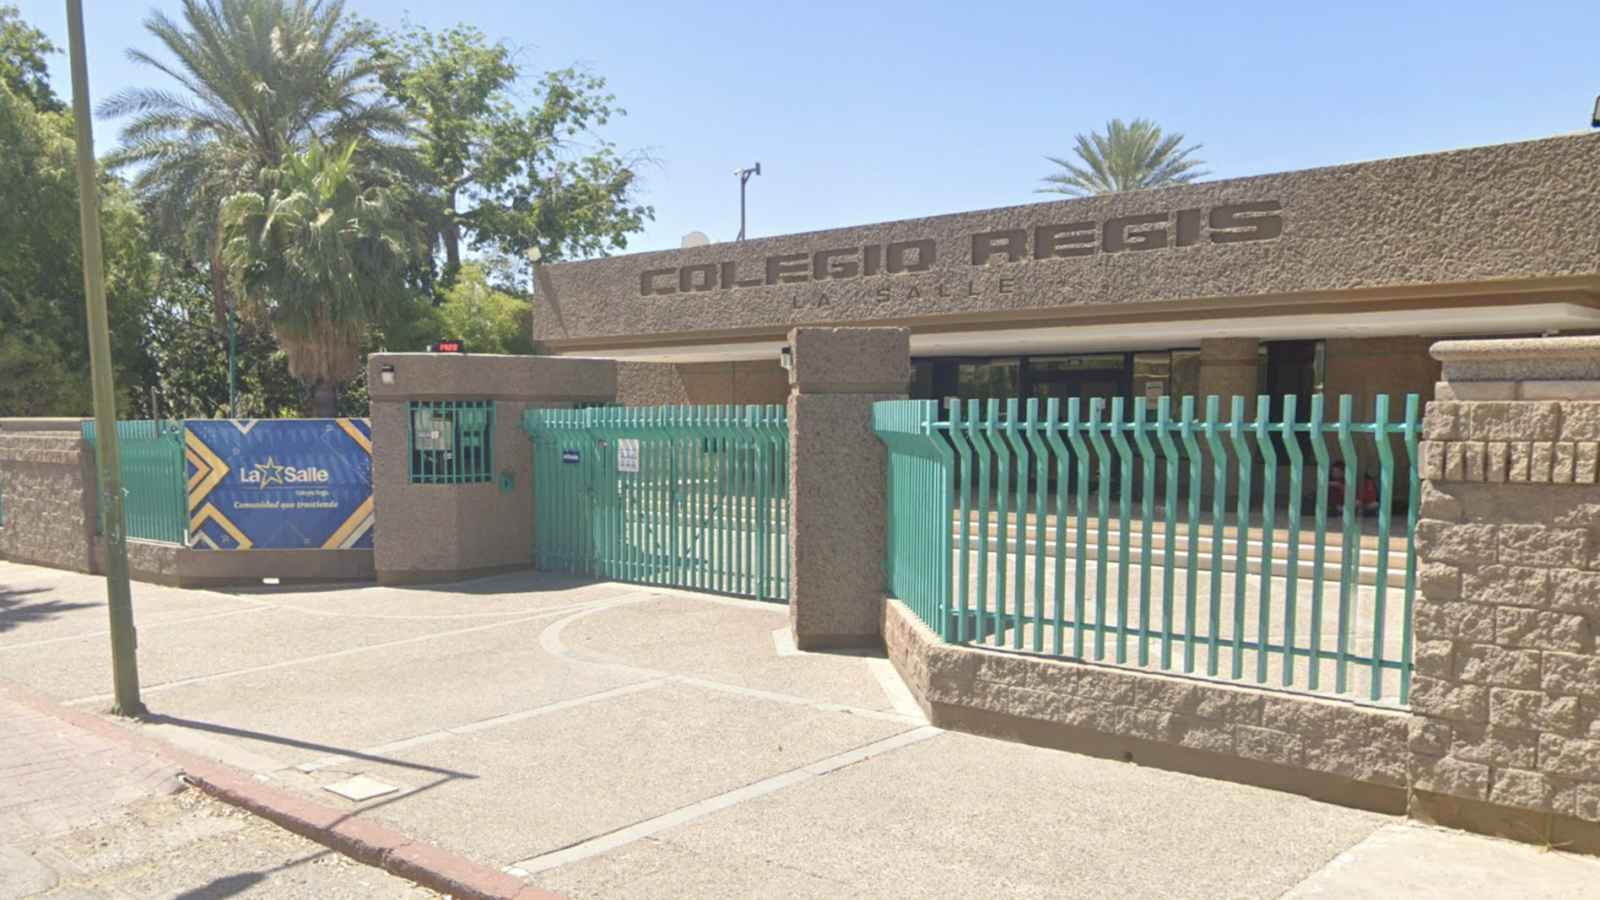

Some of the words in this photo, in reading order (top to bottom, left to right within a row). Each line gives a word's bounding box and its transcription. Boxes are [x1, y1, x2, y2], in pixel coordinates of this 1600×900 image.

[640, 238, 936, 297] COLEGIO
[971, 200, 1283, 266] REGIS
[792, 293, 830, 309] LA
[876, 278, 1014, 303] SALLE
[240, 467, 260, 482] La
[284, 466, 328, 482] Salle
[233, 501, 280, 509] Comunidad
[280, 502, 296, 510] que
[296, 500, 338, 509] trasciende
